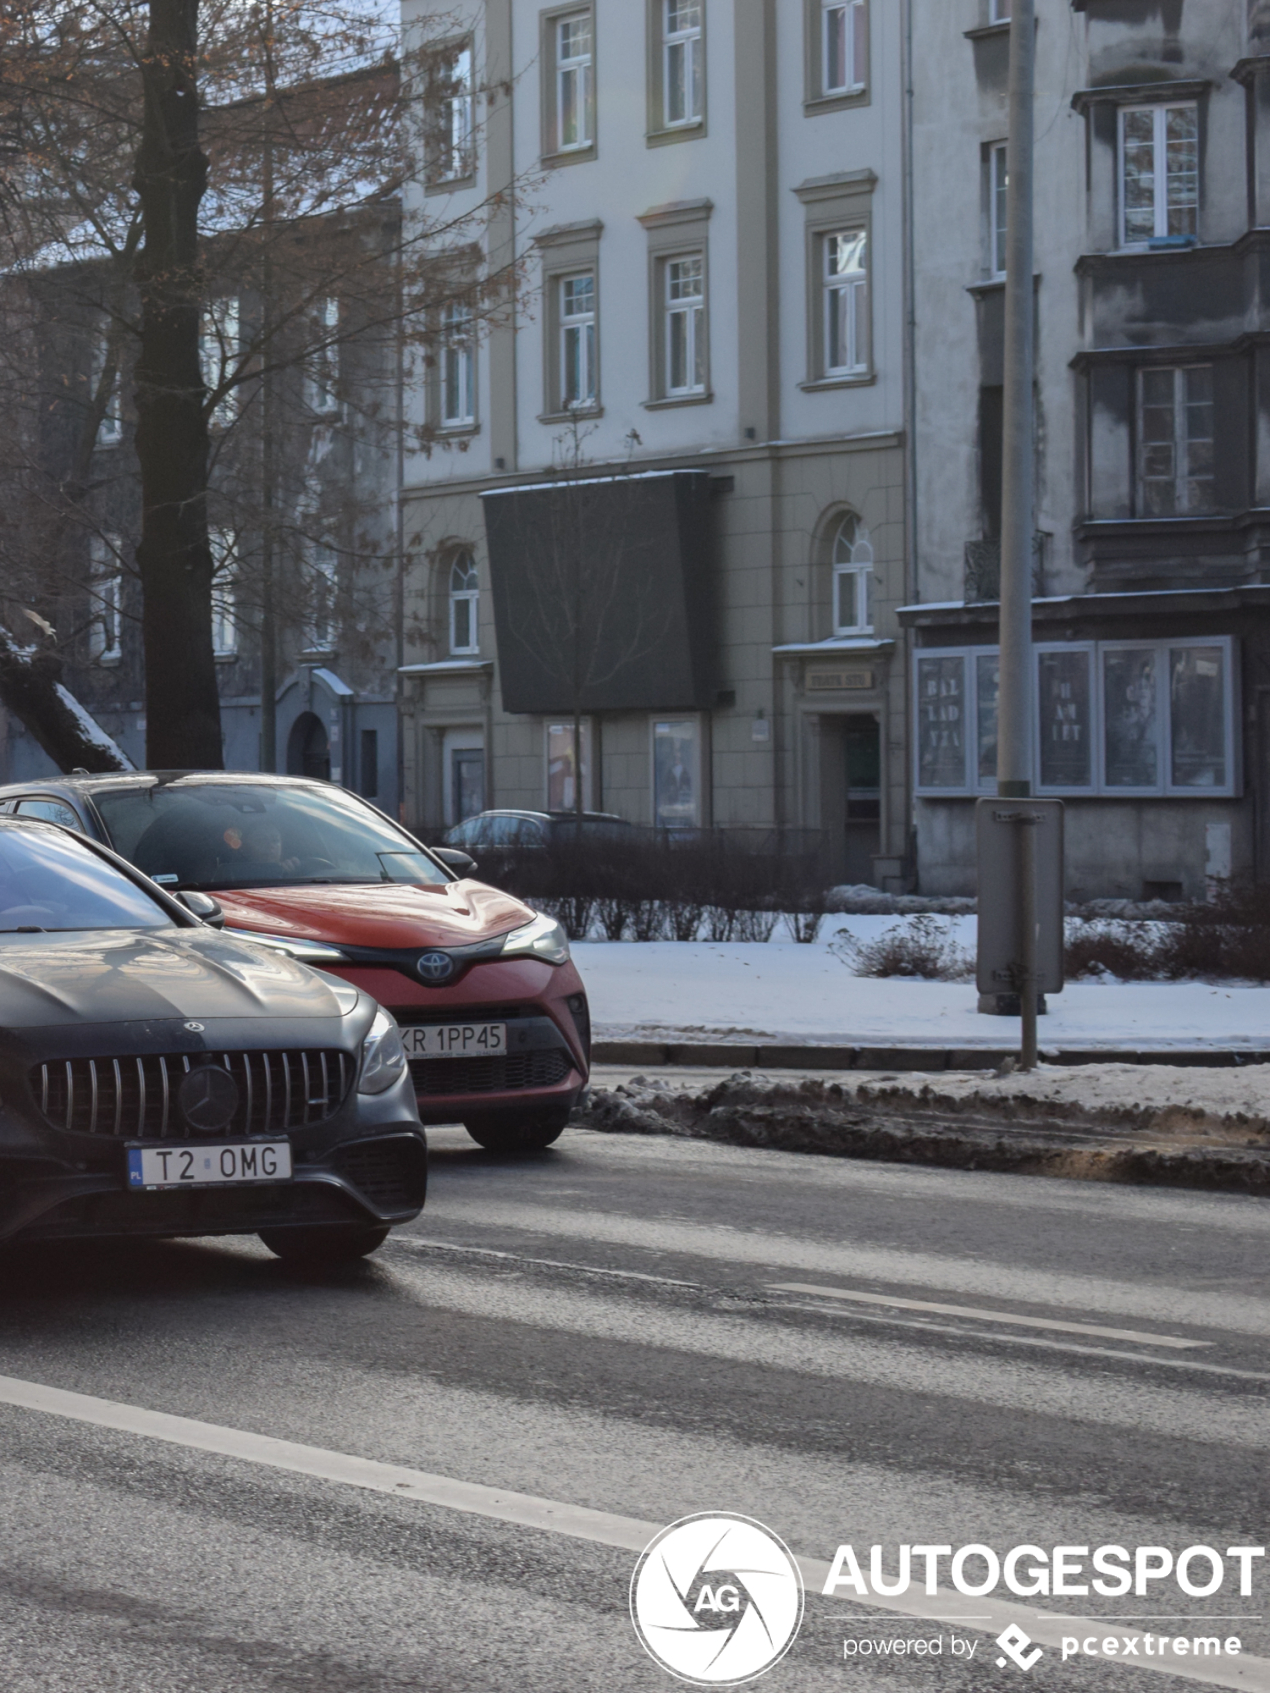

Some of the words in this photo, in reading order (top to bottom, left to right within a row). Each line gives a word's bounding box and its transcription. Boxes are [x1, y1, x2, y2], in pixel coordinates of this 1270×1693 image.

[437, 1025, 501, 1050] 1PP45
[130, 1172, 141, 1181] PL
[156, 1150, 194, 1181] T2
